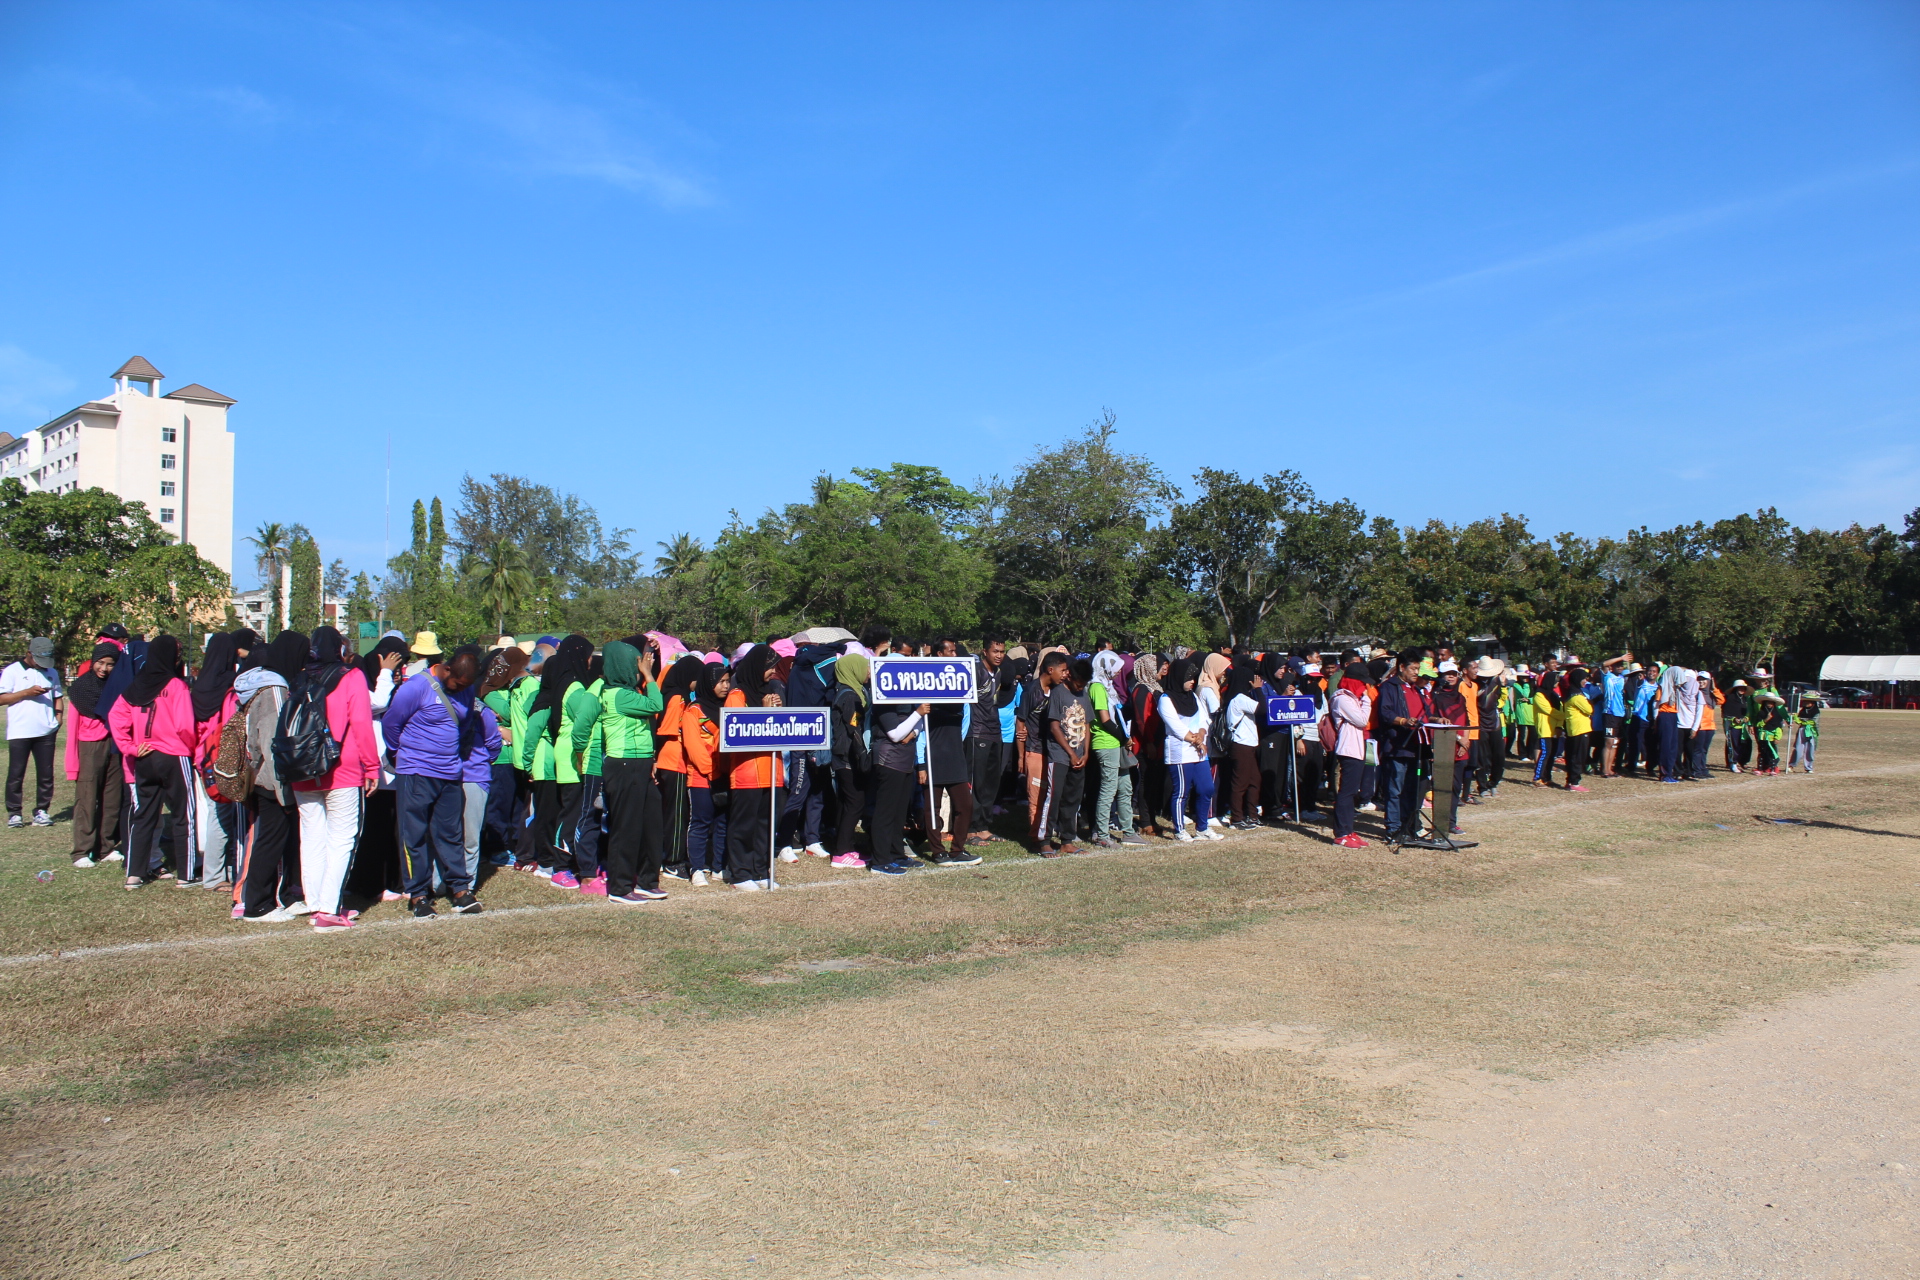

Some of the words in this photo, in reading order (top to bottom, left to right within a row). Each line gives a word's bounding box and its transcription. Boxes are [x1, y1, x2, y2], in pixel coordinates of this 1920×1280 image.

[880, 664, 968, 691] อ.หนองจิก
[728, 715, 823, 737] อำเภอเมืองปัตตานี
